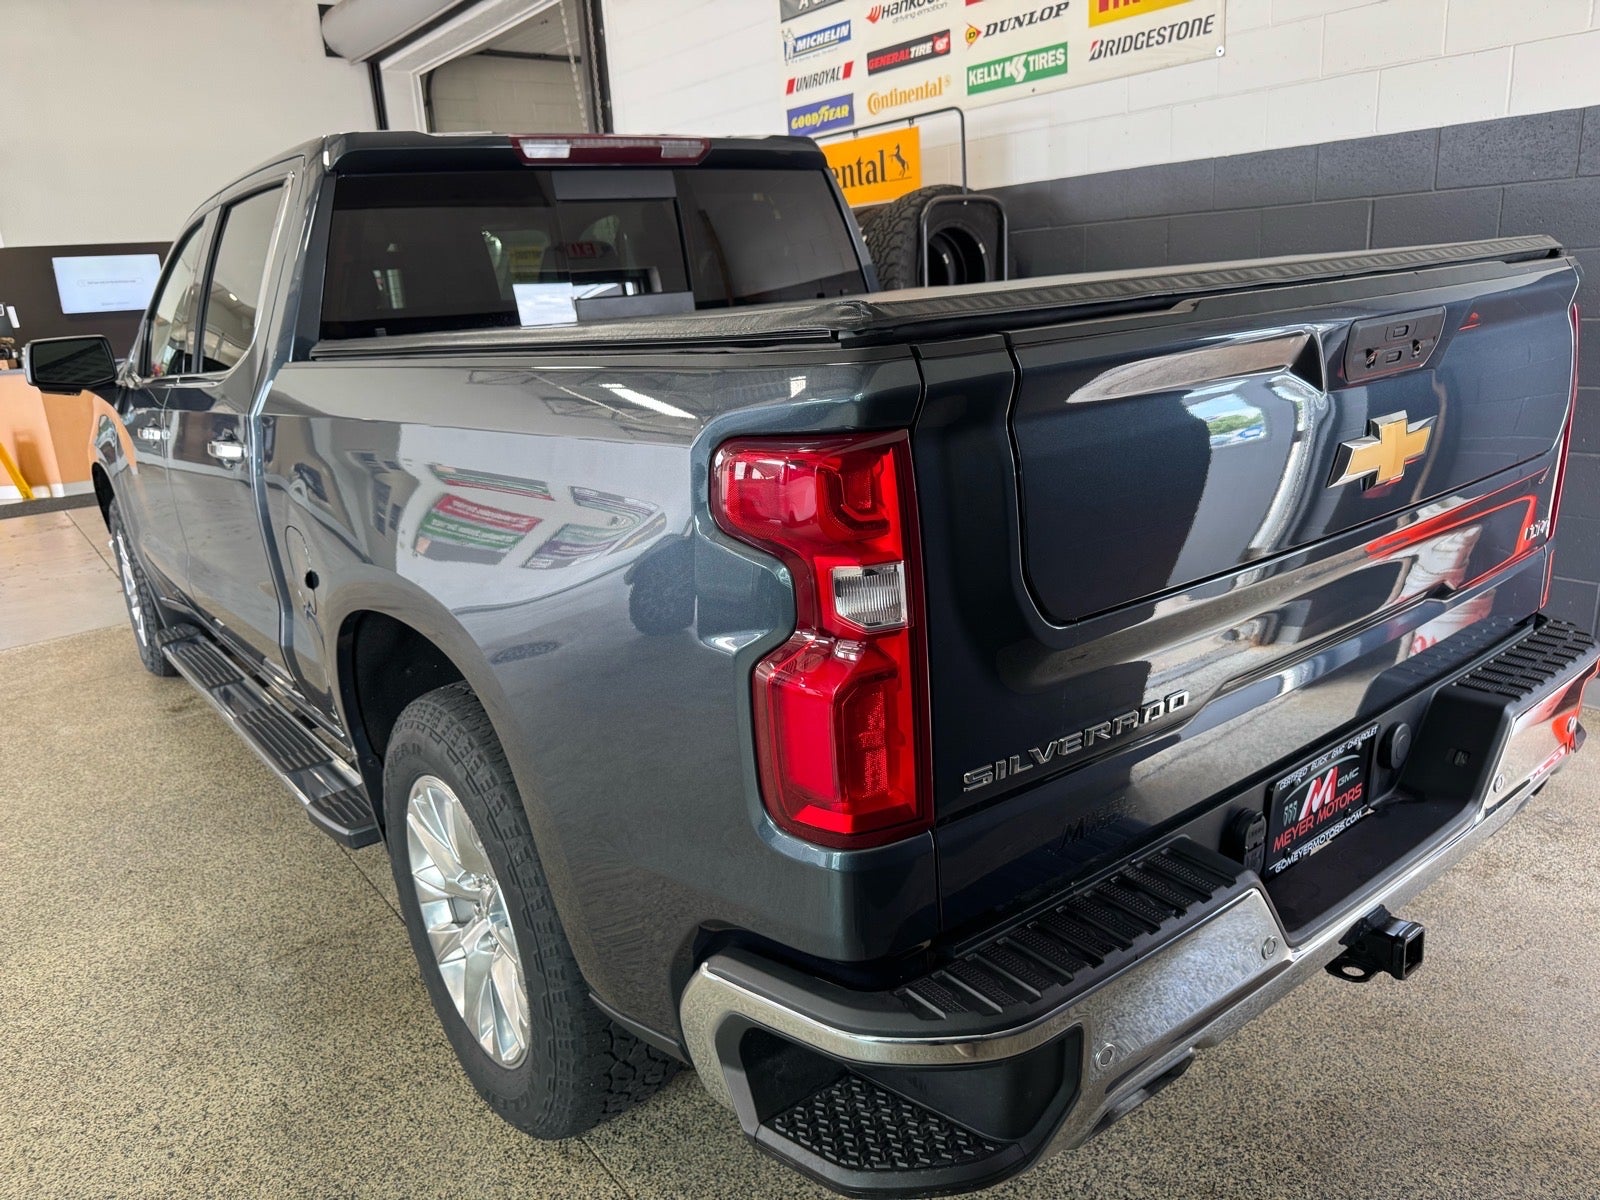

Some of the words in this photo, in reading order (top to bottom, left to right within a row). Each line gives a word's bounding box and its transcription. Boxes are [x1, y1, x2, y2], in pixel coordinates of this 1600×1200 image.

[881, 0, 939, 19] Hanko
[983, 2, 1069, 38] DUNLOP
[796, 23, 849, 52] MICHELIN
[1088, 14, 1215, 62] BRIDGESTONE
[795, 65, 842, 92] UNIROYAL
[968, 62, 1004, 86] KELLY
[1027, 48, 1066, 72] TIRES
[867, 76, 943, 115] Continental
[791, 104, 849, 129] GOODYEAR
[963, 688, 1189, 792] SILVERADO
[1347, 725, 1378, 750] CHEVROLET
[1337, 767, 1360, 787] GMC
[1273, 814, 1314, 853] MEYER
[1316, 783, 1363, 825] MOTORS
